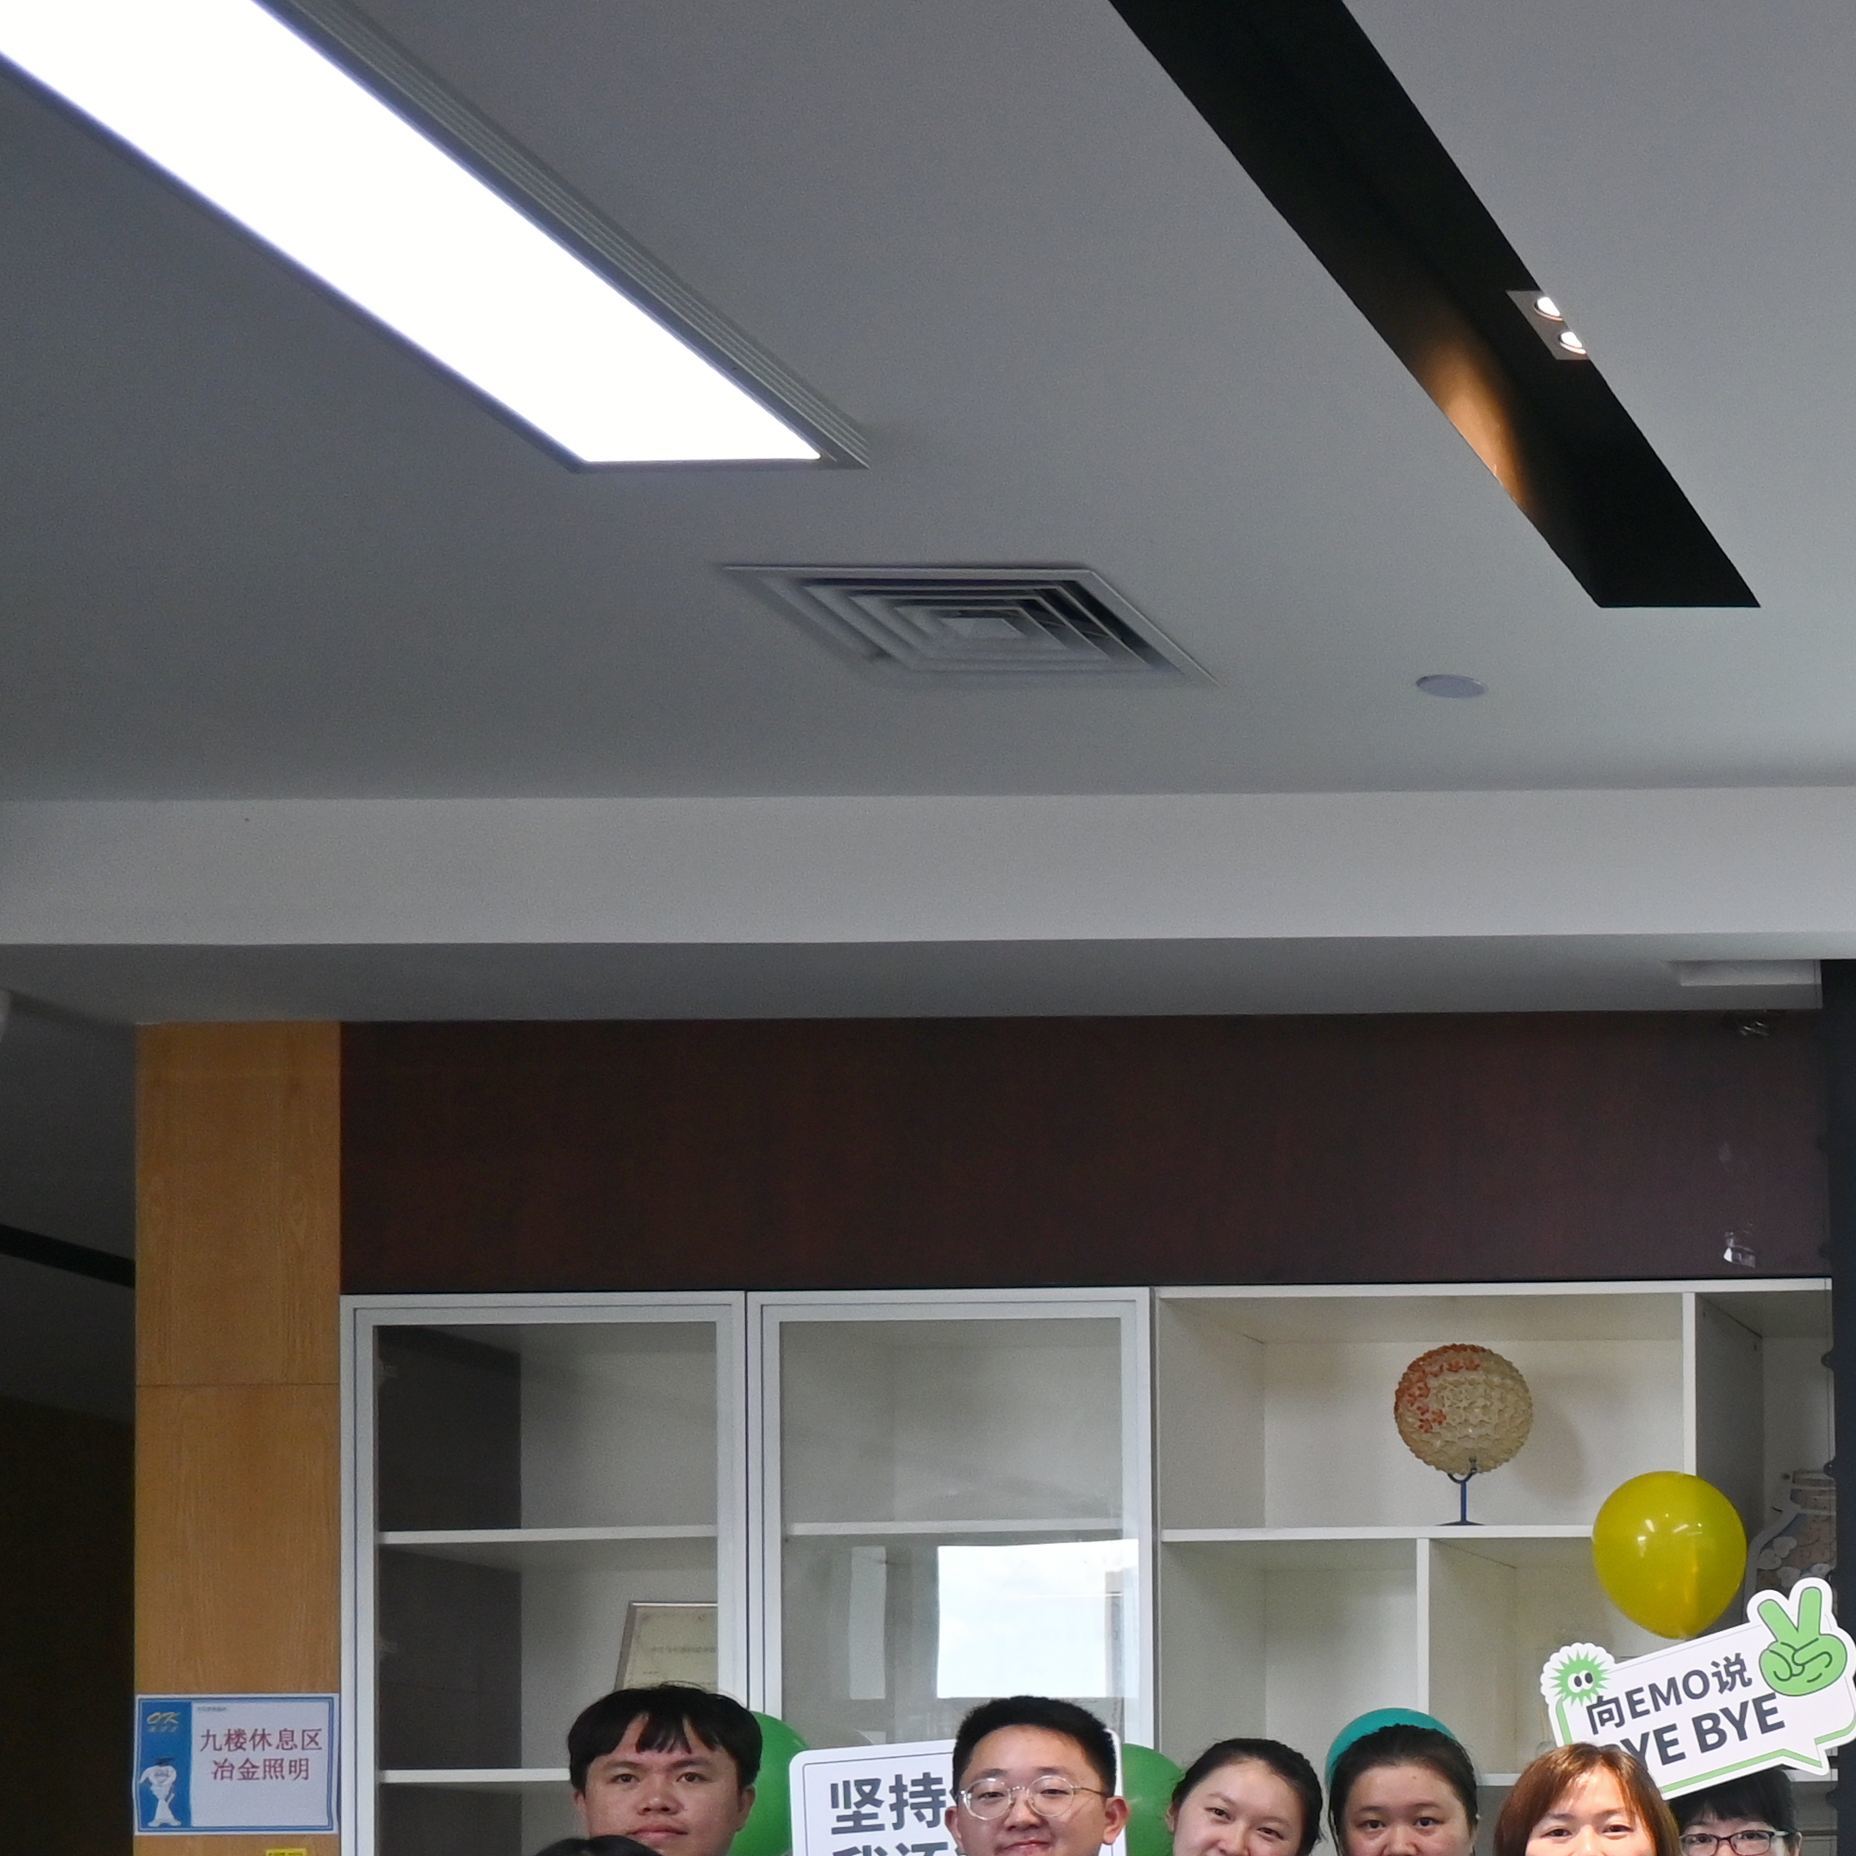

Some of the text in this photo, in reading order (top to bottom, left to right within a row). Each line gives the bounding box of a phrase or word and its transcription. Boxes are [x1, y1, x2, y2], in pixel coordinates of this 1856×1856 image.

[1586, 1653, 1752, 1734] 向EMO说
[200, 1728, 322, 1752] 九楼休息区
[1606, 1692, 1785, 1765] YE BYE
[211, 1758, 309, 1781] 冶金照明
[830, 1772, 955, 1835] 坚持
